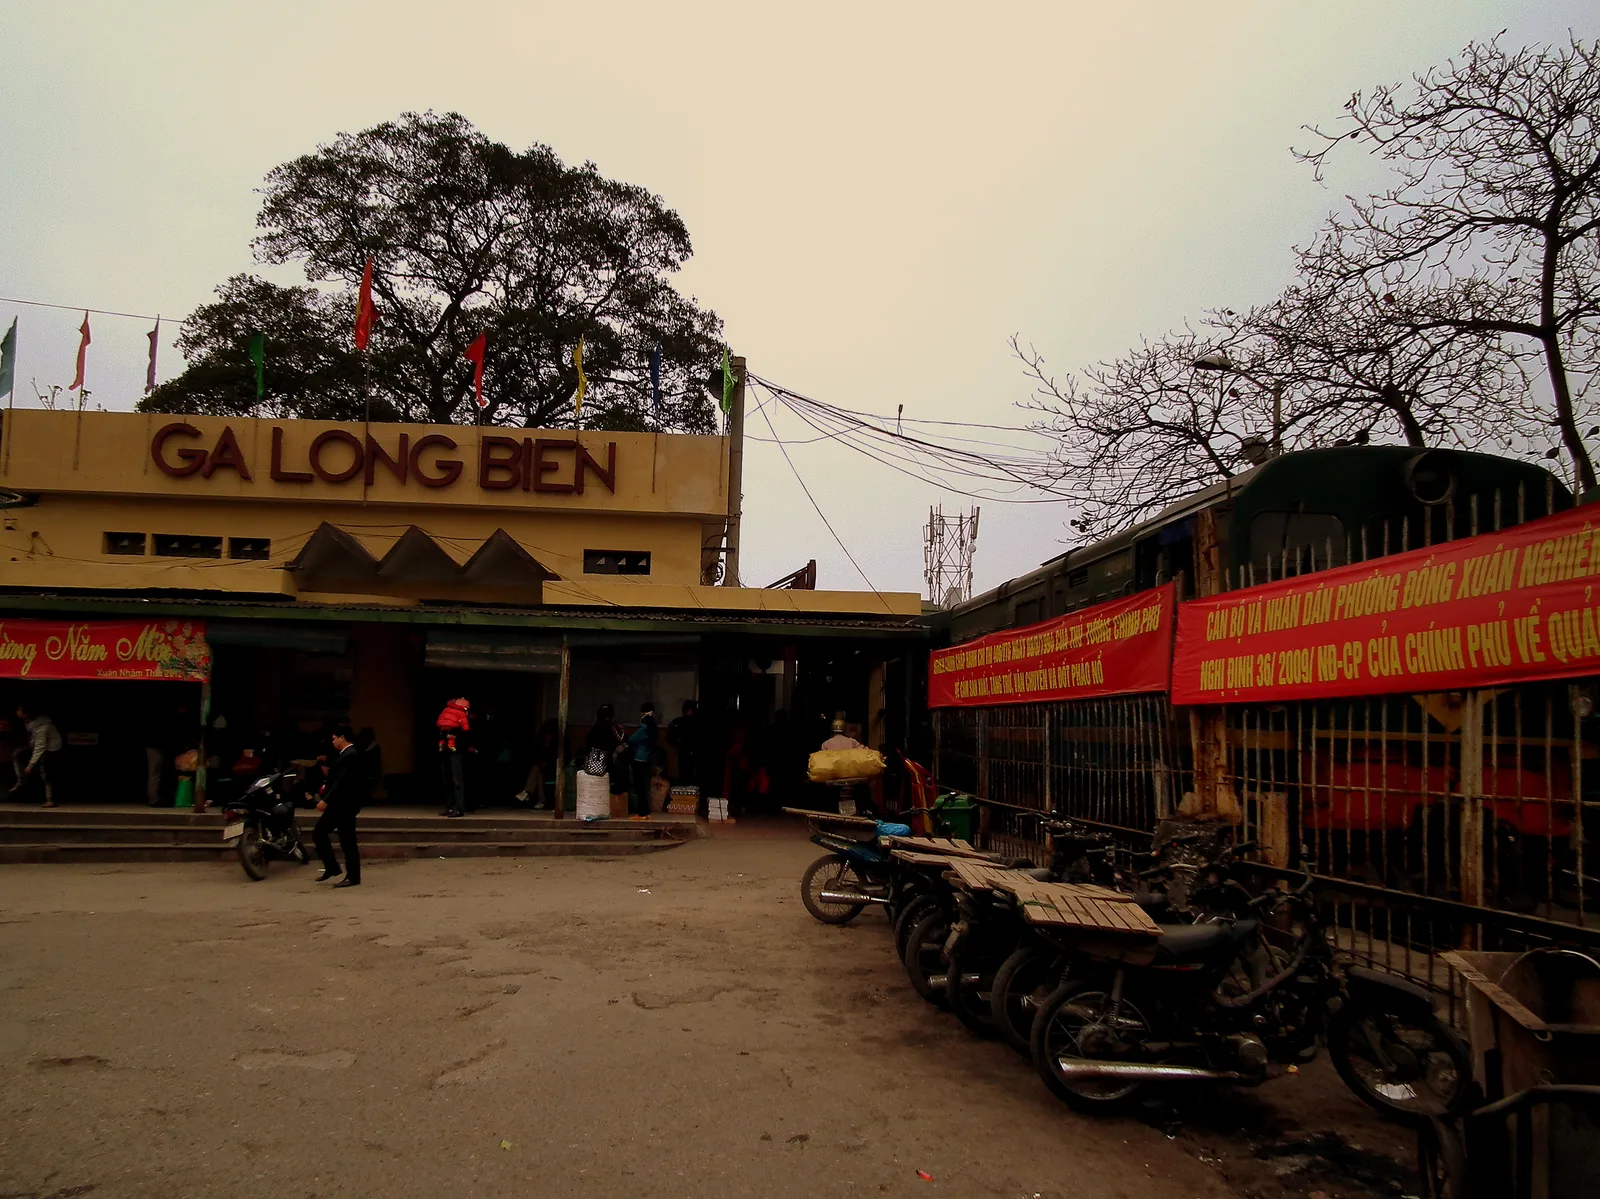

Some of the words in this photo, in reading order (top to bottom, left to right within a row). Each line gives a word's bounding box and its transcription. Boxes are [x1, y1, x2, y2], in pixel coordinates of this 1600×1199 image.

[151, 422, 254, 482] GA
[270, 427, 464, 487] LONG
[479, 435, 616, 495] BIEN
[1112, 607, 1141, 641] CHÍNH
[1140, 592, 1162, 634] PHỦ
[1206, 603, 1229, 642] CÁN
[1229, 598, 1245, 644] BỘ
[1247, 596, 1262, 635] VÀ
[1264, 589, 1302, 633] NHÂN
[1302, 579, 1334, 626] DÂN
[1334, 568, 1400, 620] PHƯỜNG
[1401, 553, 1457, 609] ĐỒNG
[1455, 543, 1519, 600] XUÂN
[45, 623, 109, 662] Năm
[1200, 658, 1225, 697] NGHỊ
[1227, 655, 1254, 697] ĐỊNH
[1317, 641, 1363, 683] NĐ-CP
[1367, 620, 1404, 678] CỦA
[1404, 620, 1465, 675] CHÍNH
[1467, 600, 1513, 669] PHỦ
[1513, 597, 1546, 664] VỀ
[97, 668, 118, 677] Xuân
[120, 668, 143, 677] Nhâm
[1071, 657, 1091, 687] PHÁO
[1091, 648, 1105, 685] NỔ
